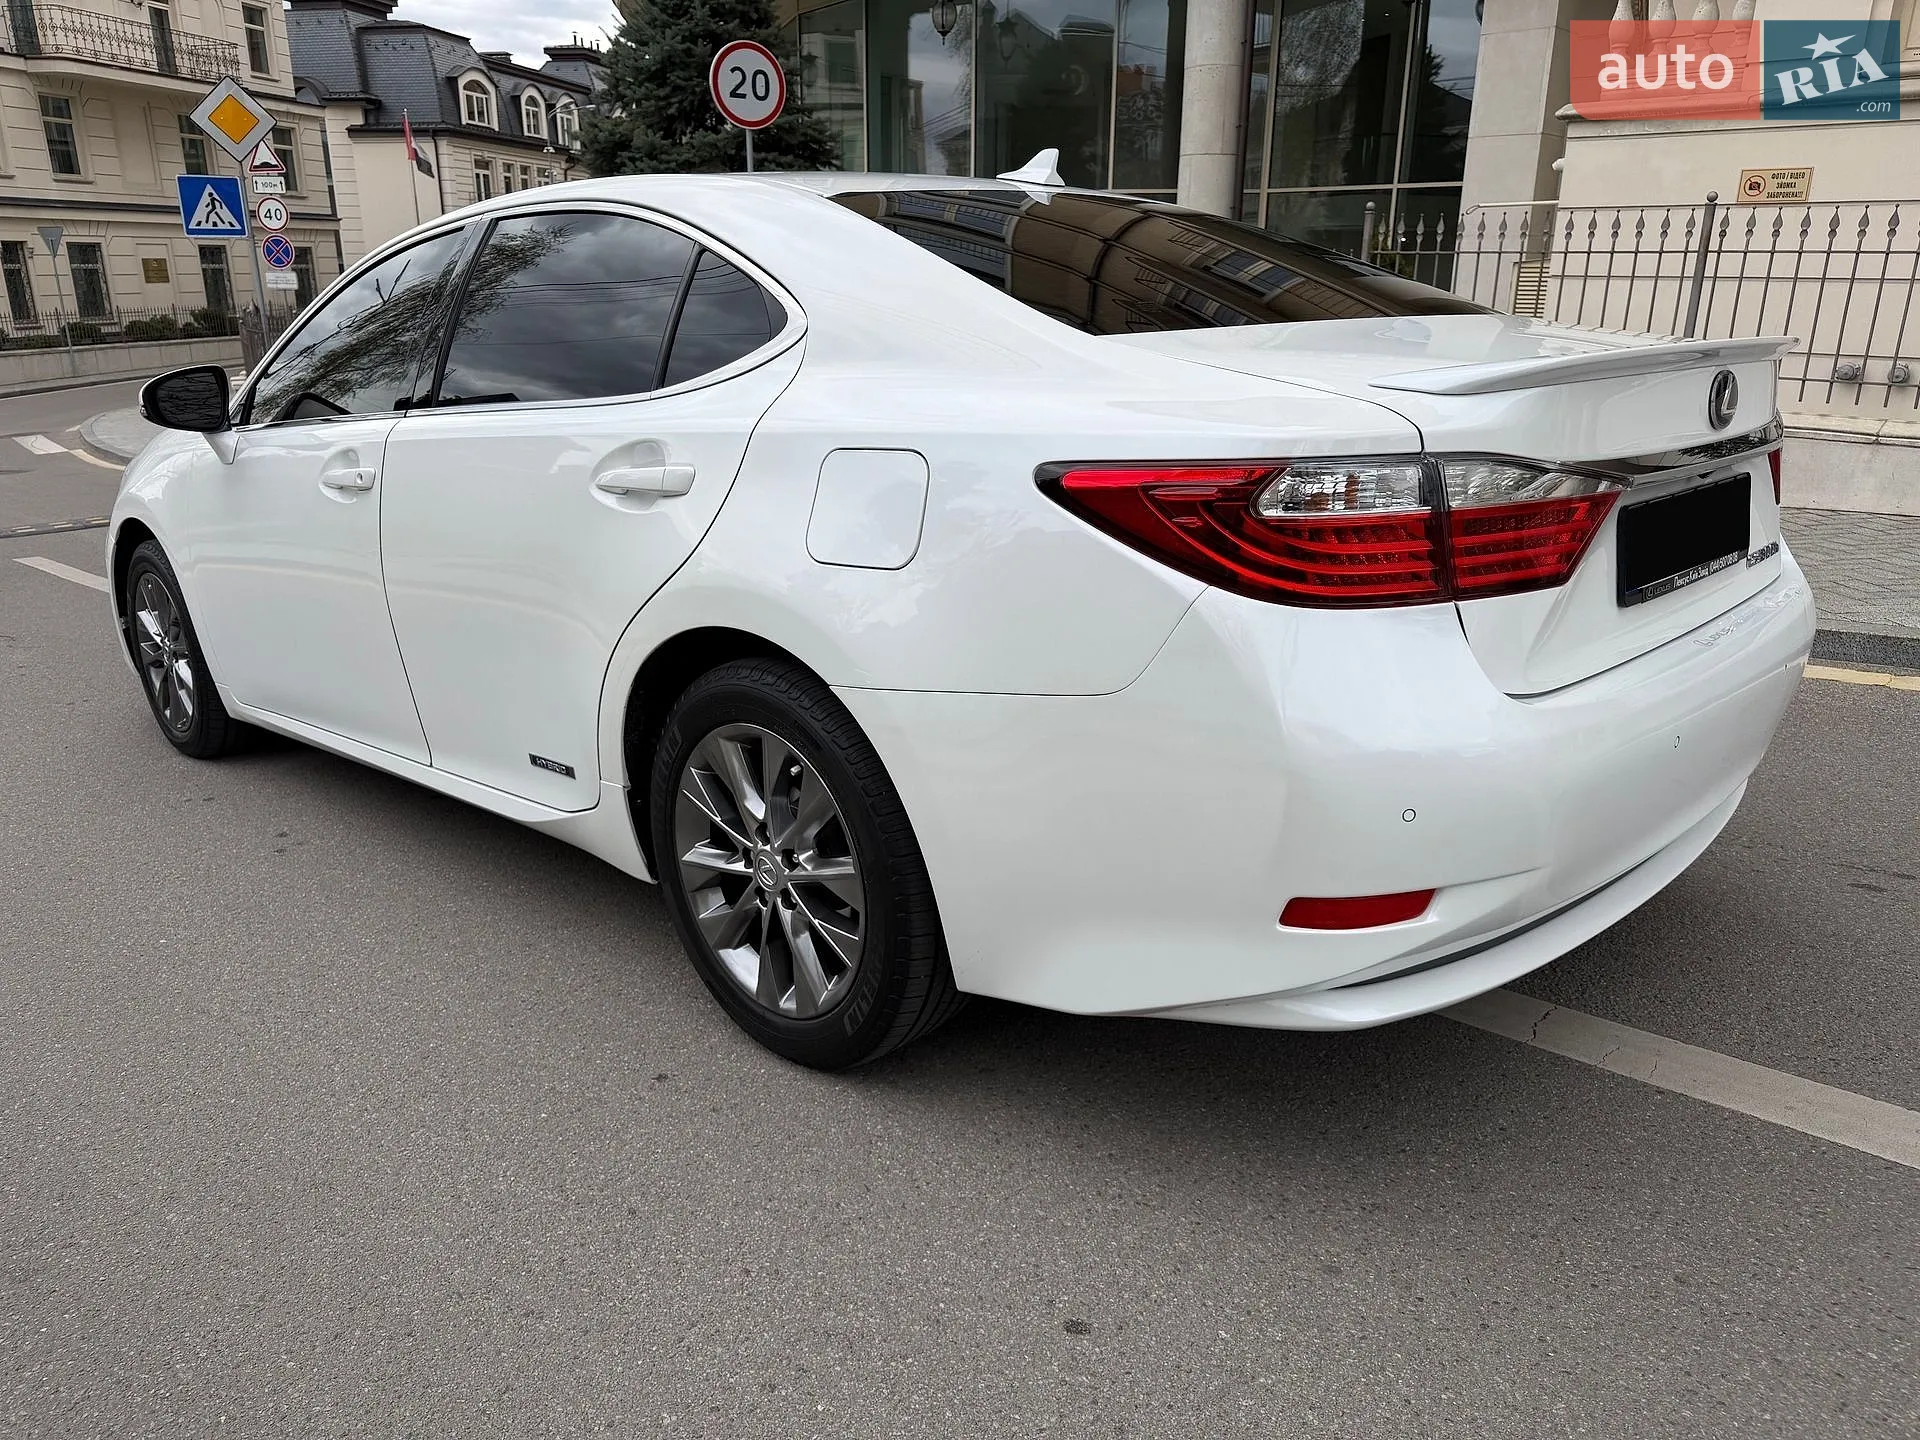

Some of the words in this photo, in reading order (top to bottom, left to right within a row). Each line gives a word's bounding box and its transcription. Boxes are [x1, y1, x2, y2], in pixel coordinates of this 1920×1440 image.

[729, 66, 770, 101] 20
[264, 208, 282, 221] 40
[535, 757, 567, 774] HYBRID
